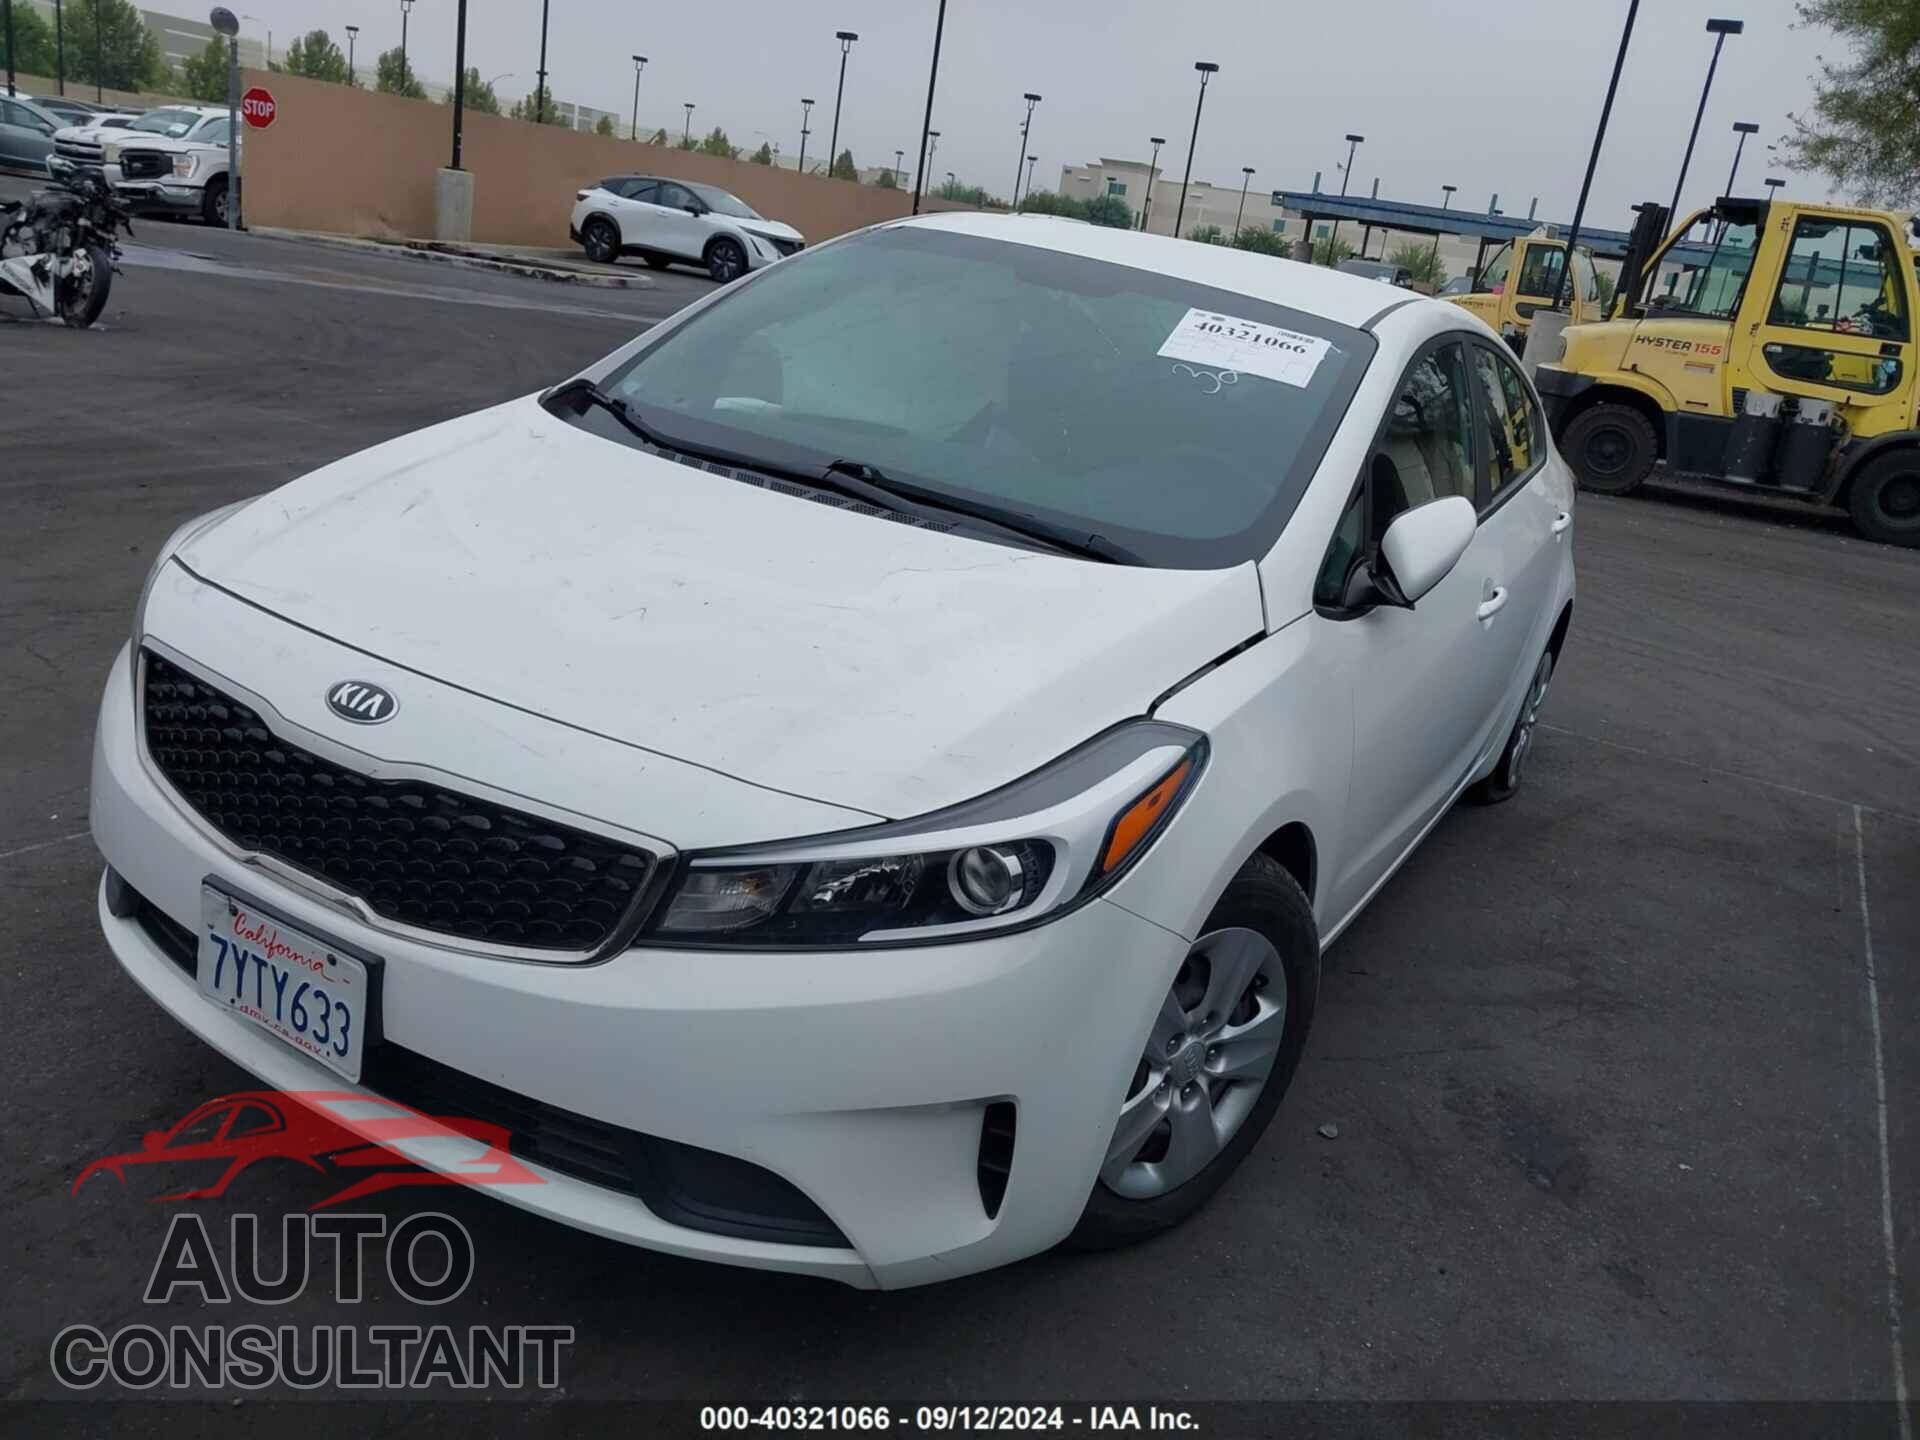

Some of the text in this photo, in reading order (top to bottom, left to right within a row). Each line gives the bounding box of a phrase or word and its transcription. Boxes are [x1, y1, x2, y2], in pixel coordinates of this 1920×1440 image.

[243, 98, 274, 119] STOP
[1195, 321, 1307, 355] 40321066
[1634, 334, 1692, 353] HYSTER
[1694, 343, 1722, 356] 155
[331, 682, 385, 718] KIA
[233, 912, 338, 983] California
[209, 932, 351, 1058] 7YTY633
